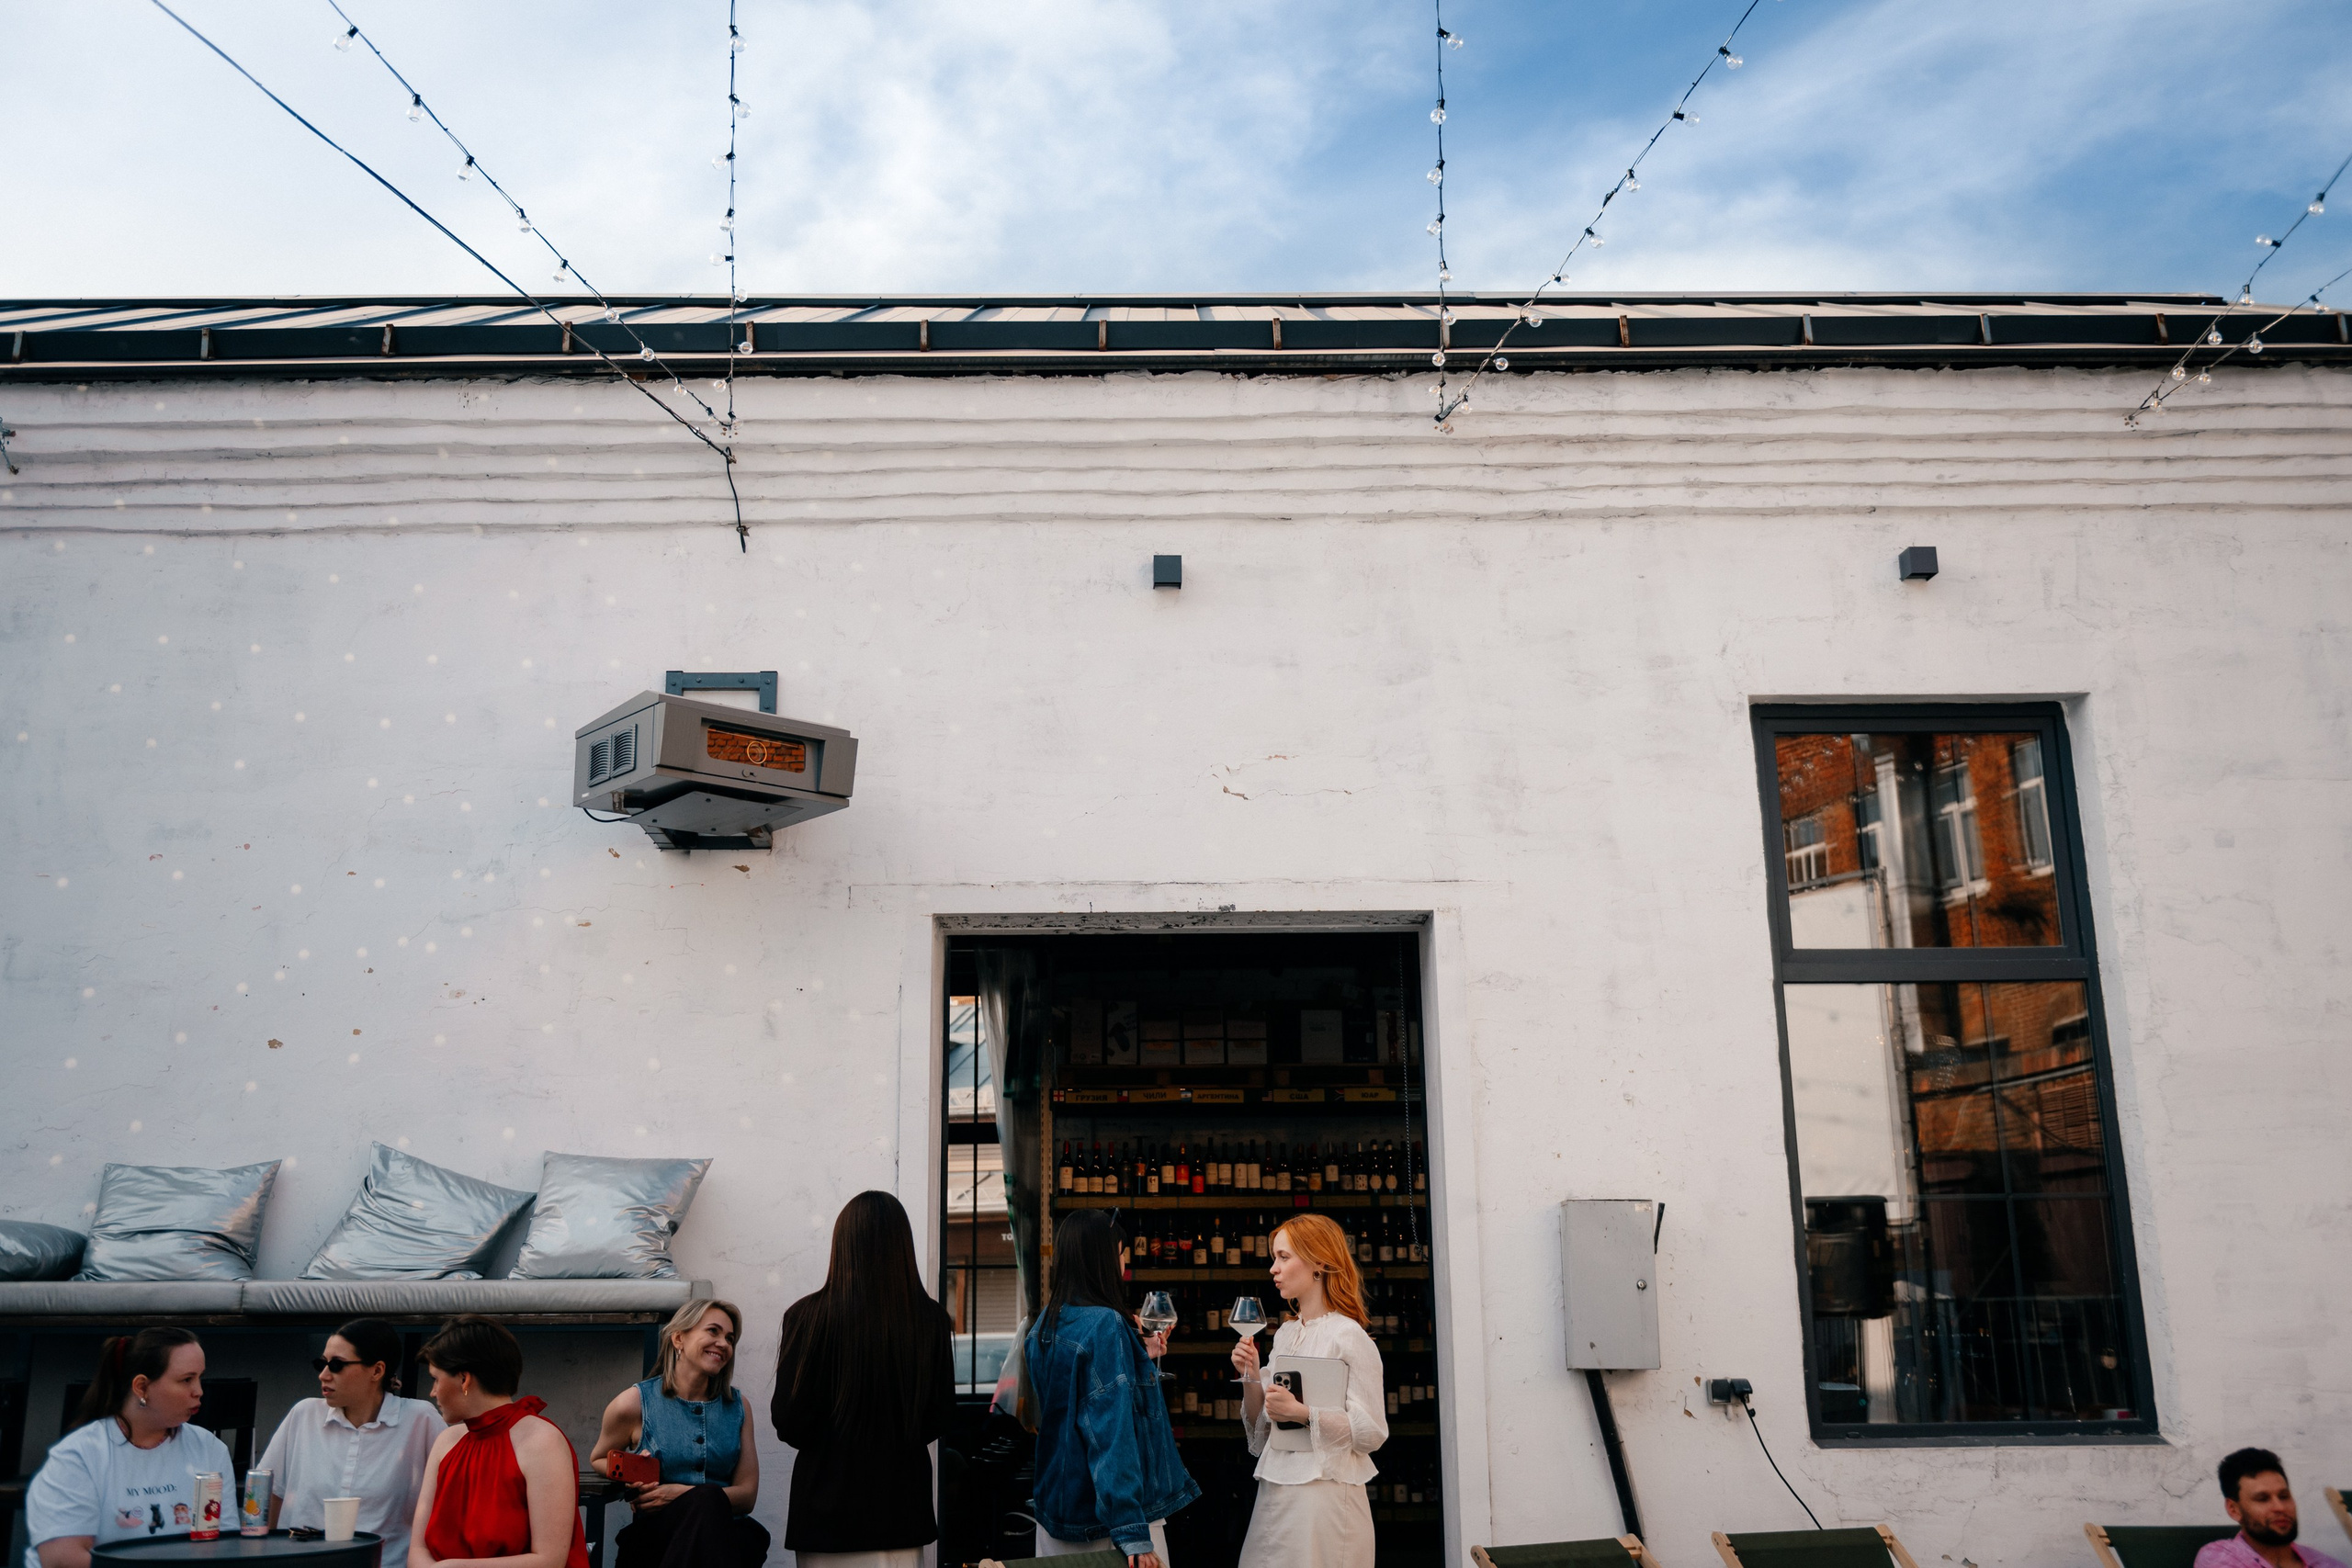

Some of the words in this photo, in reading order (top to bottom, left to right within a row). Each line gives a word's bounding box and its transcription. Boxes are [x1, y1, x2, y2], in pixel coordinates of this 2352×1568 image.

[1076, 1094, 1108, 1102] ГРУЗИЯ
[126, 1487, 140, 1496] MY
[142, 1483, 177, 1495] MOOD:
